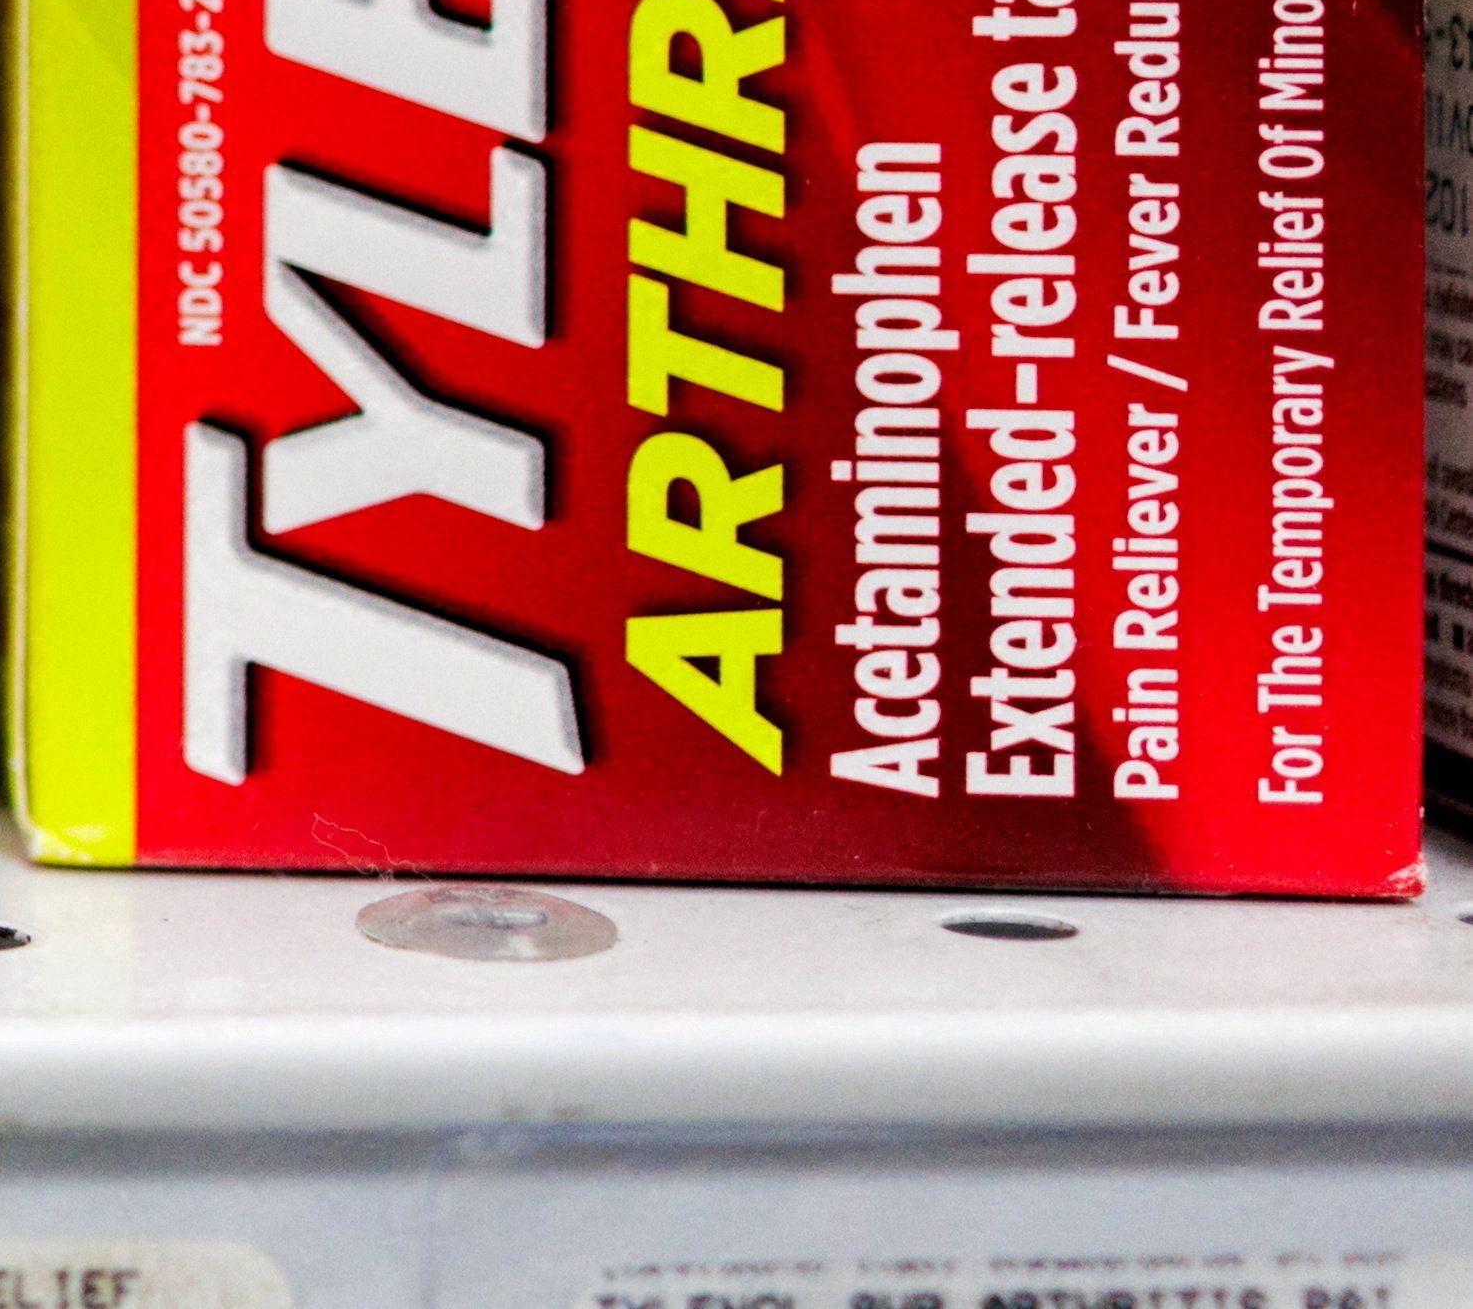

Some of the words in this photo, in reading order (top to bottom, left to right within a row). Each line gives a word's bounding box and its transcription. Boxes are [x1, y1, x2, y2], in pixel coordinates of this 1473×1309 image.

[1259, 124, 1324, 178] Of
[179, 262, 222, 345] NDC
[1114, 173, 1180, 339] Fever
[1258, 192, 1324, 330] Relief
[831, 143, 958, 797] Acetaminophen
[966, 63, 1077, 796] Extended-release
[1258, 346, 1334, 612] Temporary
[1113, 403, 1179, 650] Reliever
[1113, 669, 1179, 799] Pain
[1257, 625, 1323, 713] The
[1258, 726, 1323, 804] For
